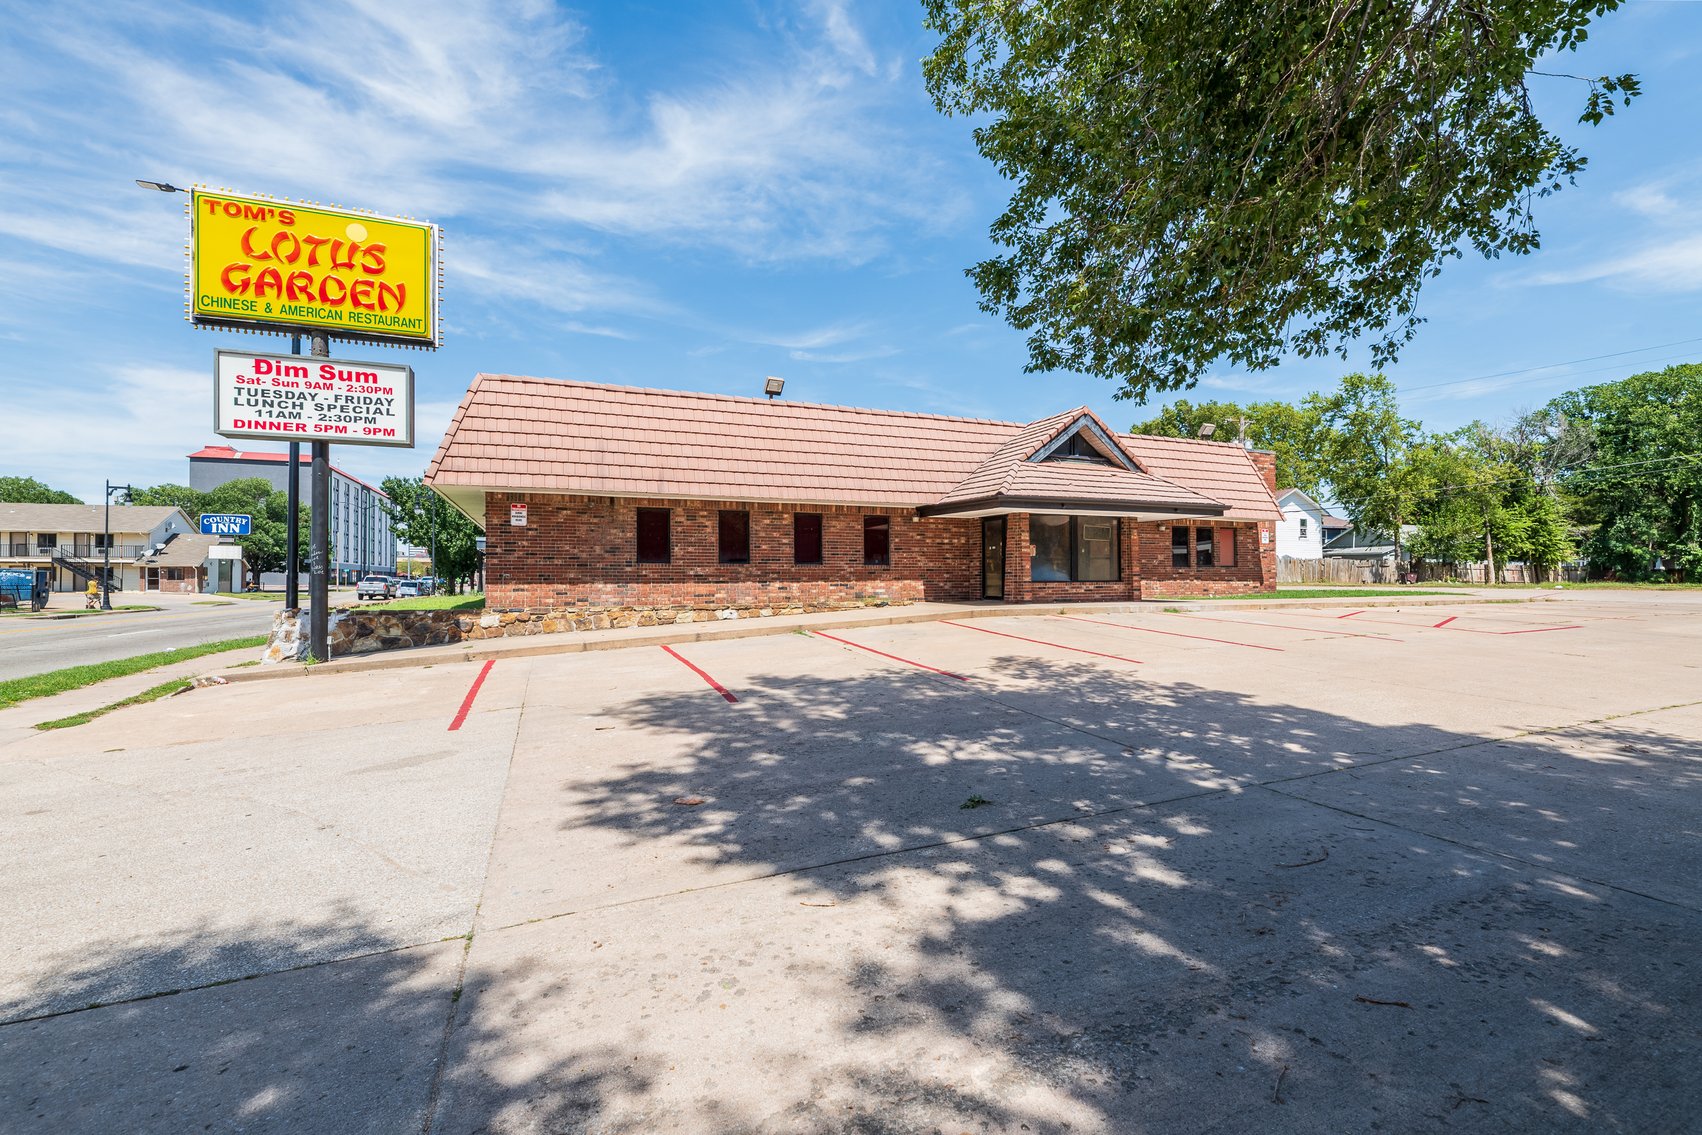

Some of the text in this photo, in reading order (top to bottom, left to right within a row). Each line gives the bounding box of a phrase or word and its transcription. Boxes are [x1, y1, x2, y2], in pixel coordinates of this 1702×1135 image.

[203, 199, 295, 226] TOM'S
[241, 227, 386, 275] LOTUS
[221, 262, 406, 313] GARDEN
[201, 296, 422, 329] CHINESE & AMERICAN RESTAURANT
[319, 365, 377, 384] Sum
[272, 378, 299, 388] Sun
[305, 381, 333, 391] 9AM
[346, 385, 393, 395] 2:30PM
[234, 387, 318, 401] TUESDAY
[335, 395, 394, 406] FRIDAY
[234, 398, 395, 416] LUNCH SPECIAL
[255, 410, 301, 419] 11AM
[319, 414, 376, 424] 2:30PM
[234, 419, 307, 432] DINNER
[314, 424, 347, 434] 5PM
[363, 427, 395, 436] 9PM
[204, 516, 248, 525] COUNTRY
[211, 523, 240, 533] INN
